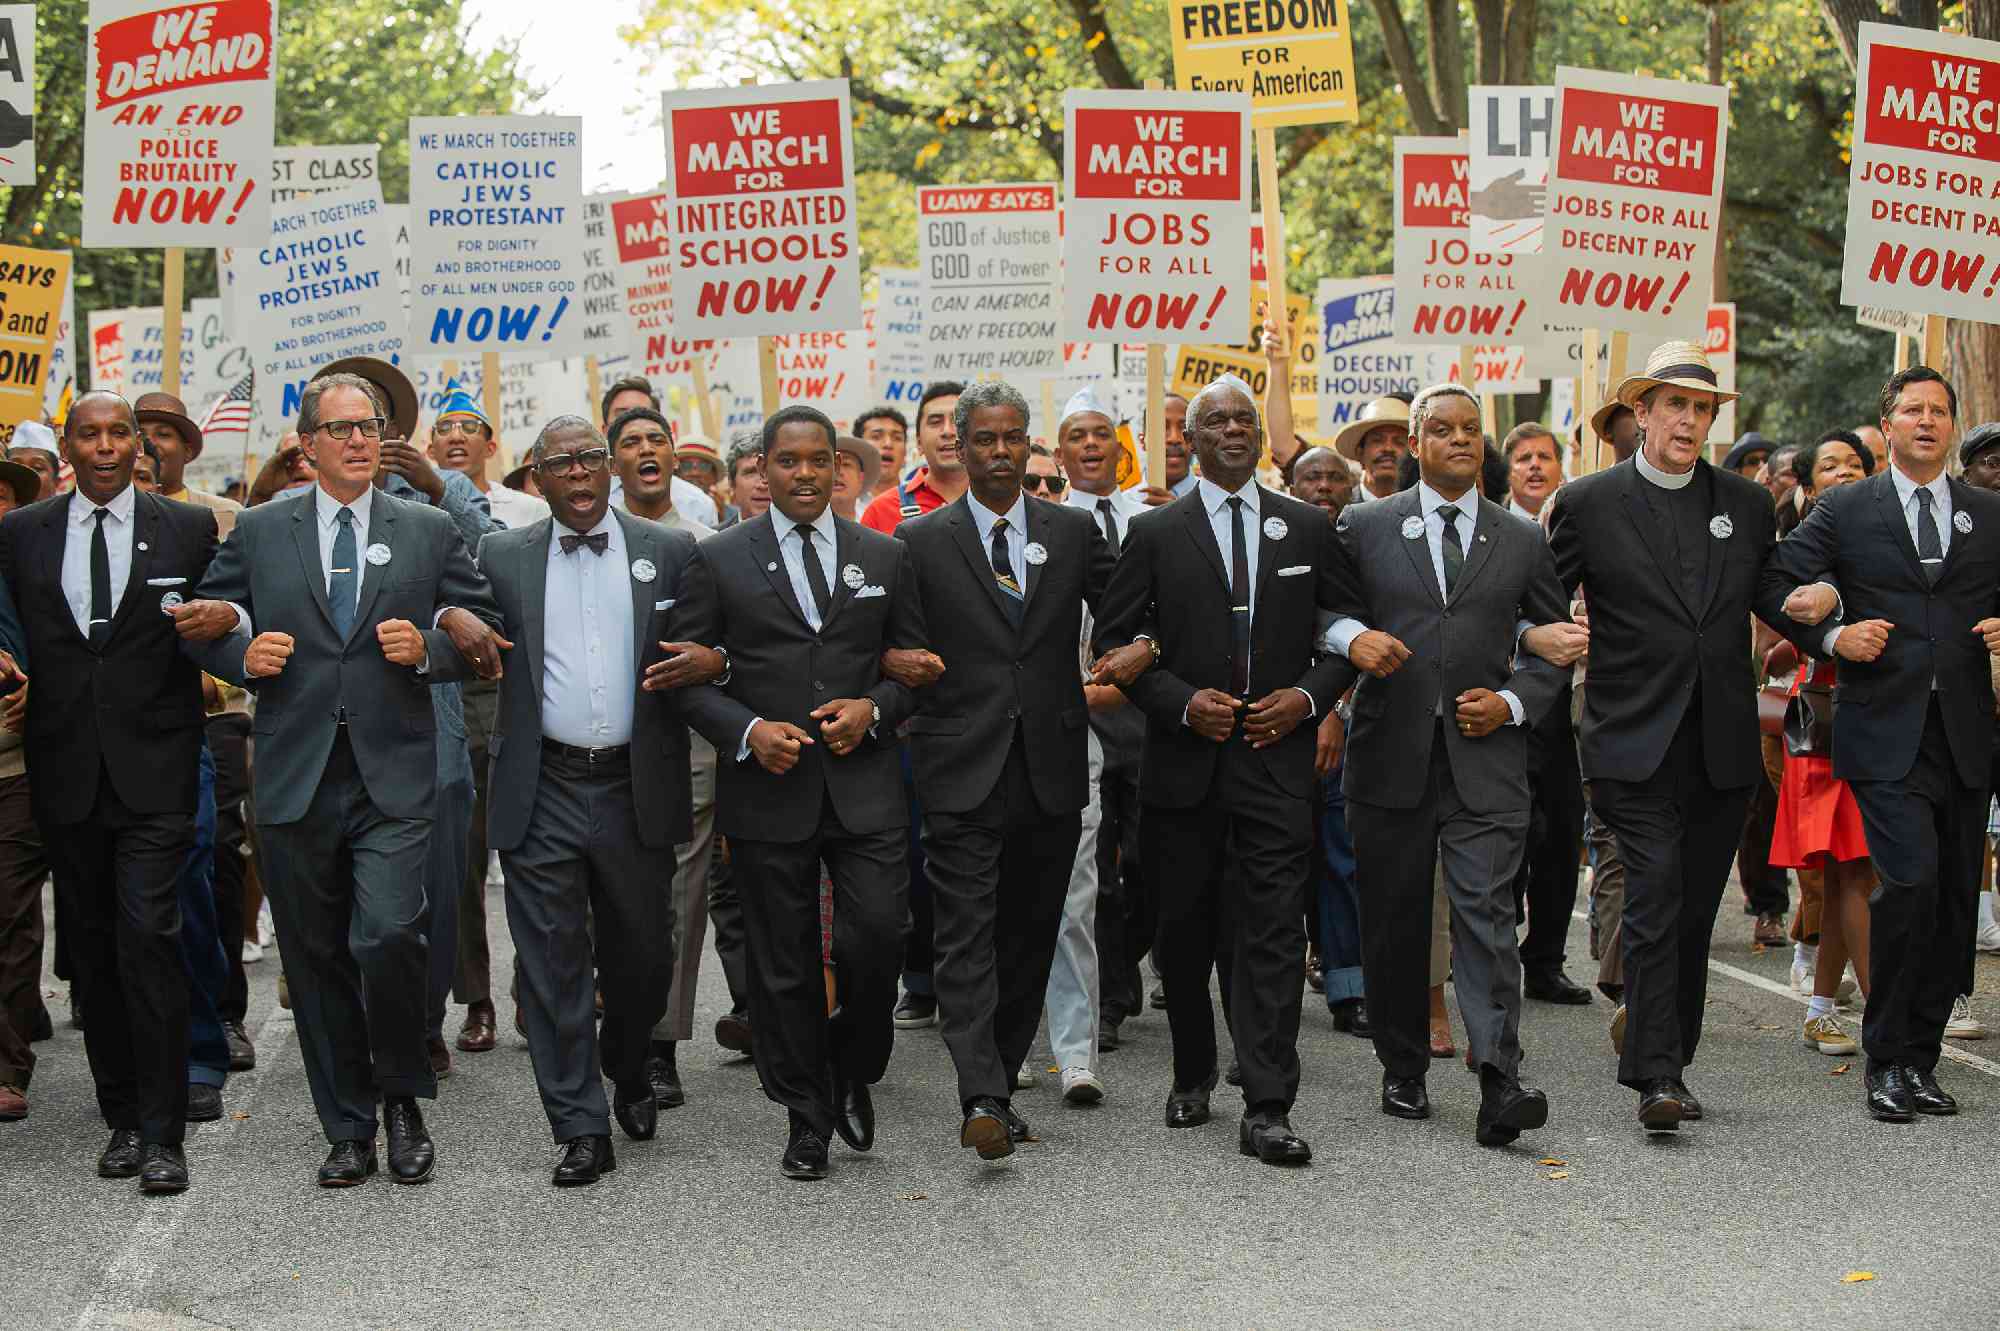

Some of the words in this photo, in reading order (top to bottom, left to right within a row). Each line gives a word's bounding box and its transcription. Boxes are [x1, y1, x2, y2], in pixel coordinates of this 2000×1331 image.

[152, 6, 219, 49] WE
[1182, 0, 1338, 40] FREEDOM
[105, 33, 265, 99] DEMAND
[1242, 48, 1290, 66] FOR
[1252, 66, 1344, 98] American
[1931, 59, 1982, 95] WE
[112, 104, 163, 126] AN
[176, 105, 244, 127] END
[730, 110, 781, 136] WE
[1618, 101, 1665, 131] WE
[164, 128, 192, 137] TO
[419, 133, 439, 150] WE
[444, 133, 495, 149] MARCH
[501, 131, 577, 148] TOGETHER
[1135, 116, 1184, 142] WE
[1927, 129, 1978, 154] FOR
[140, 139, 219, 158] POLICE
[688, 135, 828, 173] MARCH
[1088, 144, 1228, 177] MARCH
[1571, 125, 1704, 170] MARCH
[120, 163, 238, 182] BRUTALITY
[309, 157, 374, 181] CLASS
[436, 160, 557, 180] CATHOLIC
[734, 171, 785, 191] FOR
[1613, 165, 1659, 187] FOR
[1860, 160, 1928, 189] JOBS
[1936, 171, 1984, 198] FOR
[461, 184, 532, 203] JEWS
[1135, 179, 1184, 196] FOR
[1413, 183, 1470, 208] MA
[112, 178, 256, 226] NOW!
[311, 200, 378, 226] TOGETHER
[927, 194, 984, 211] UAW
[988, 191, 1049, 210] SAYS:
[1553, 194, 1613, 219] JOBS
[1620, 201, 1665, 225] FOR
[1672, 208, 1710, 231] ALL
[428, 206, 566, 227] PROTESTANT
[676, 195, 846, 234] INTEGRATED
[1871, 199, 1966, 232] DECENT
[928, 221, 967, 247] GOD
[970, 226, 986, 245] of
[992, 225, 1051, 246] Justice
[1102, 213, 1211, 246] JOBS
[259, 229, 367, 265] CATHOLIC
[457, 240, 483, 252] FOR
[488, 239, 538, 251] DIGNITY
[679, 232, 849, 268] SCHOOLS
[1562, 229, 1648, 257] DECENT
[1654, 239, 1697, 262] PAY
[287, 256, 349, 283] JEWS
[434, 262, 461, 274] AND
[465, 259, 561, 274] BROTHERHOOD
[931, 253, 969, 280] GOD
[977, 257, 994, 278] of
[1000, 258, 1051, 278] Power
[1099, 256, 1151, 274] FOR
[1168, 257, 1213, 274] ALL
[259, 271, 381, 311] PROTESTANT
[421, 284, 438, 296] OF
[443, 282, 466, 295] ALL
[470, 282, 497, 294] MEN
[502, 281, 544, 293] UNDER
[548, 280, 576, 293] GOD
[697, 264, 837, 318] NOW!
[1423, 274, 1466, 289] FOR
[1479, 274, 1516, 290] ALL
[1560, 267, 1691, 316] NOW!
[931, 295, 970, 312] CAN
[974, 292, 1050, 311] AMERICA
[1087, 285, 1228, 331] NOW!
[8, 312, 49, 335] and
[291, 315, 315, 329] FOR
[317, 305, 362, 326] DIGNITY
[430, 295, 569, 344] NOW!
[1413, 299, 1527, 336] NOW!
[274, 338, 298, 353] AND
[302, 321, 387, 347] BROTHERHOOD
[800, 331, 848, 349] FEPC
[929, 324, 973, 342] DENY
[977, 320, 1056, 340] FREEDOM
[264, 362, 280, 376] OF
[285, 356, 306, 371] ALL
[310, 350, 334, 366] MEN
[338, 342, 375, 359] UNDER
[379, 338, 403, 353] GOD
[779, 353, 827, 370] LAW
[933, 353, 951, 369] IN
[957, 351, 995, 369] THIS
[999, 349, 1055, 368] HOUR?
[1333, 355, 1414, 373] DECENT
[1325, 377, 1420, 395] HOUSING
